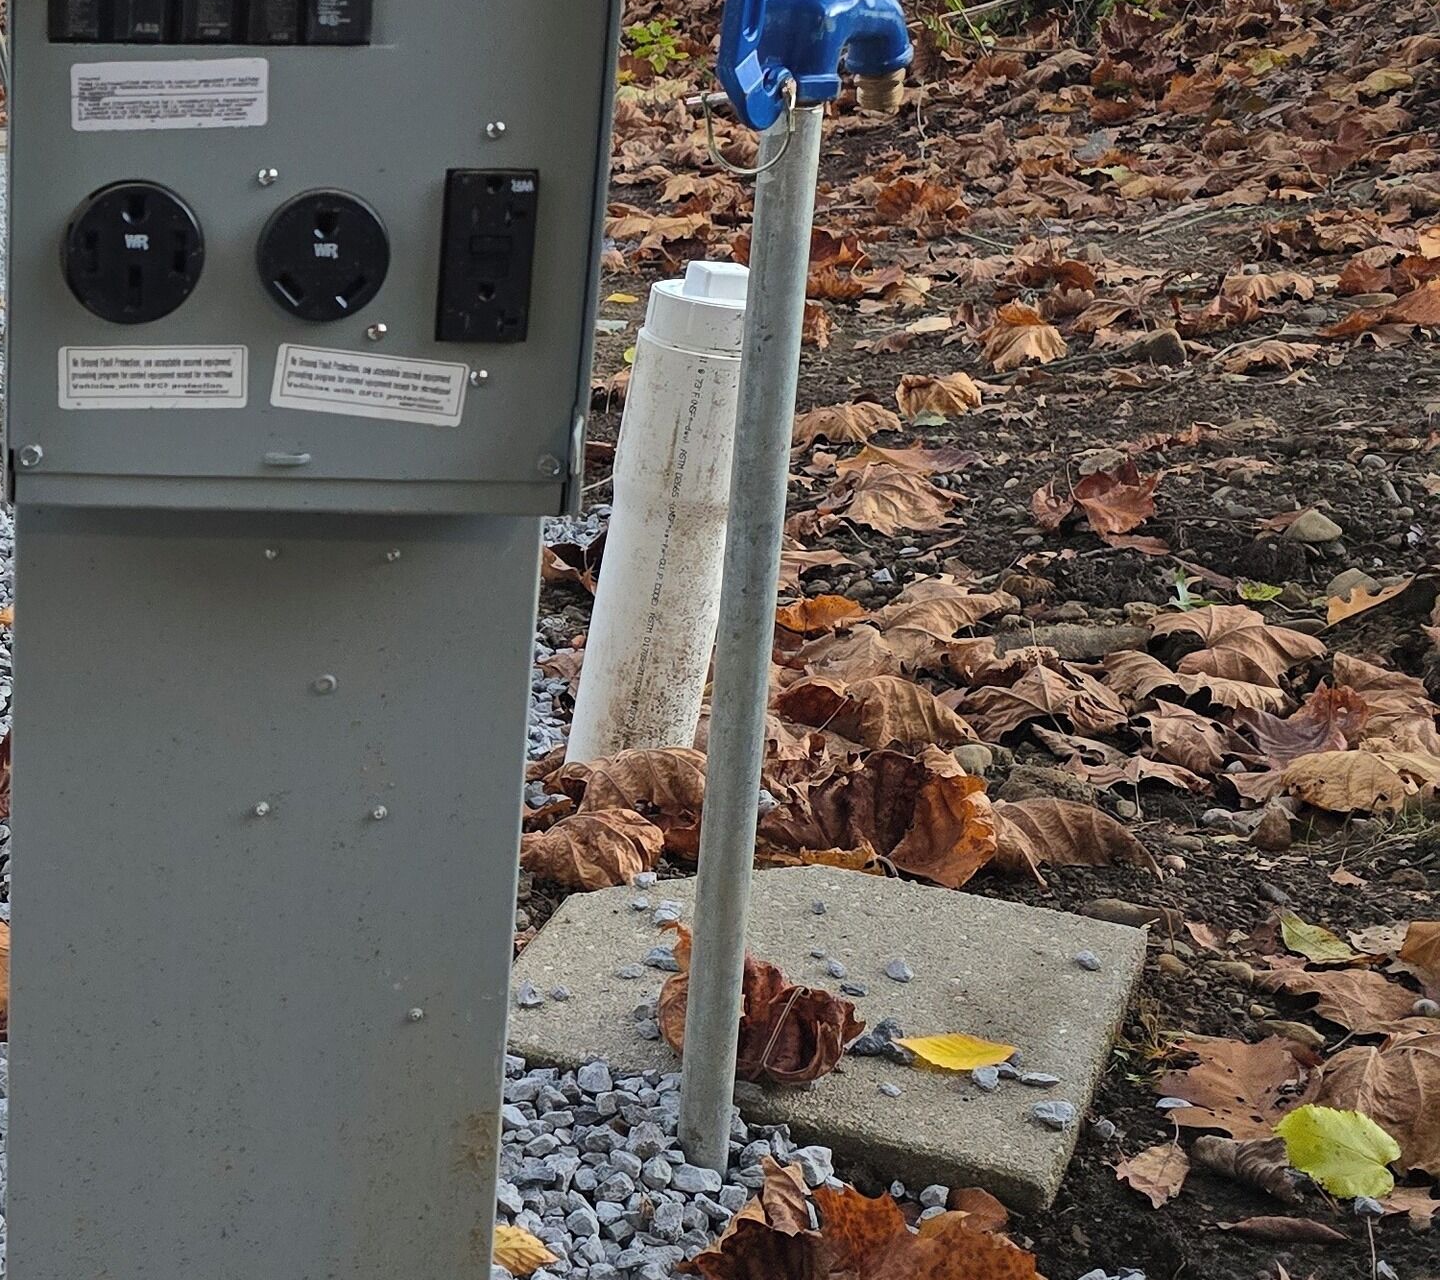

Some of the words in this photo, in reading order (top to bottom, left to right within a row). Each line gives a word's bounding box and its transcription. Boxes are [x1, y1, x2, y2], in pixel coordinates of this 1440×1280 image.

[124, 234, 149, 251] WR
[313, 243, 339, 259] WR
[677, 448, 688, 470] ASTM
[644, 611, 655, 633] ASTM
